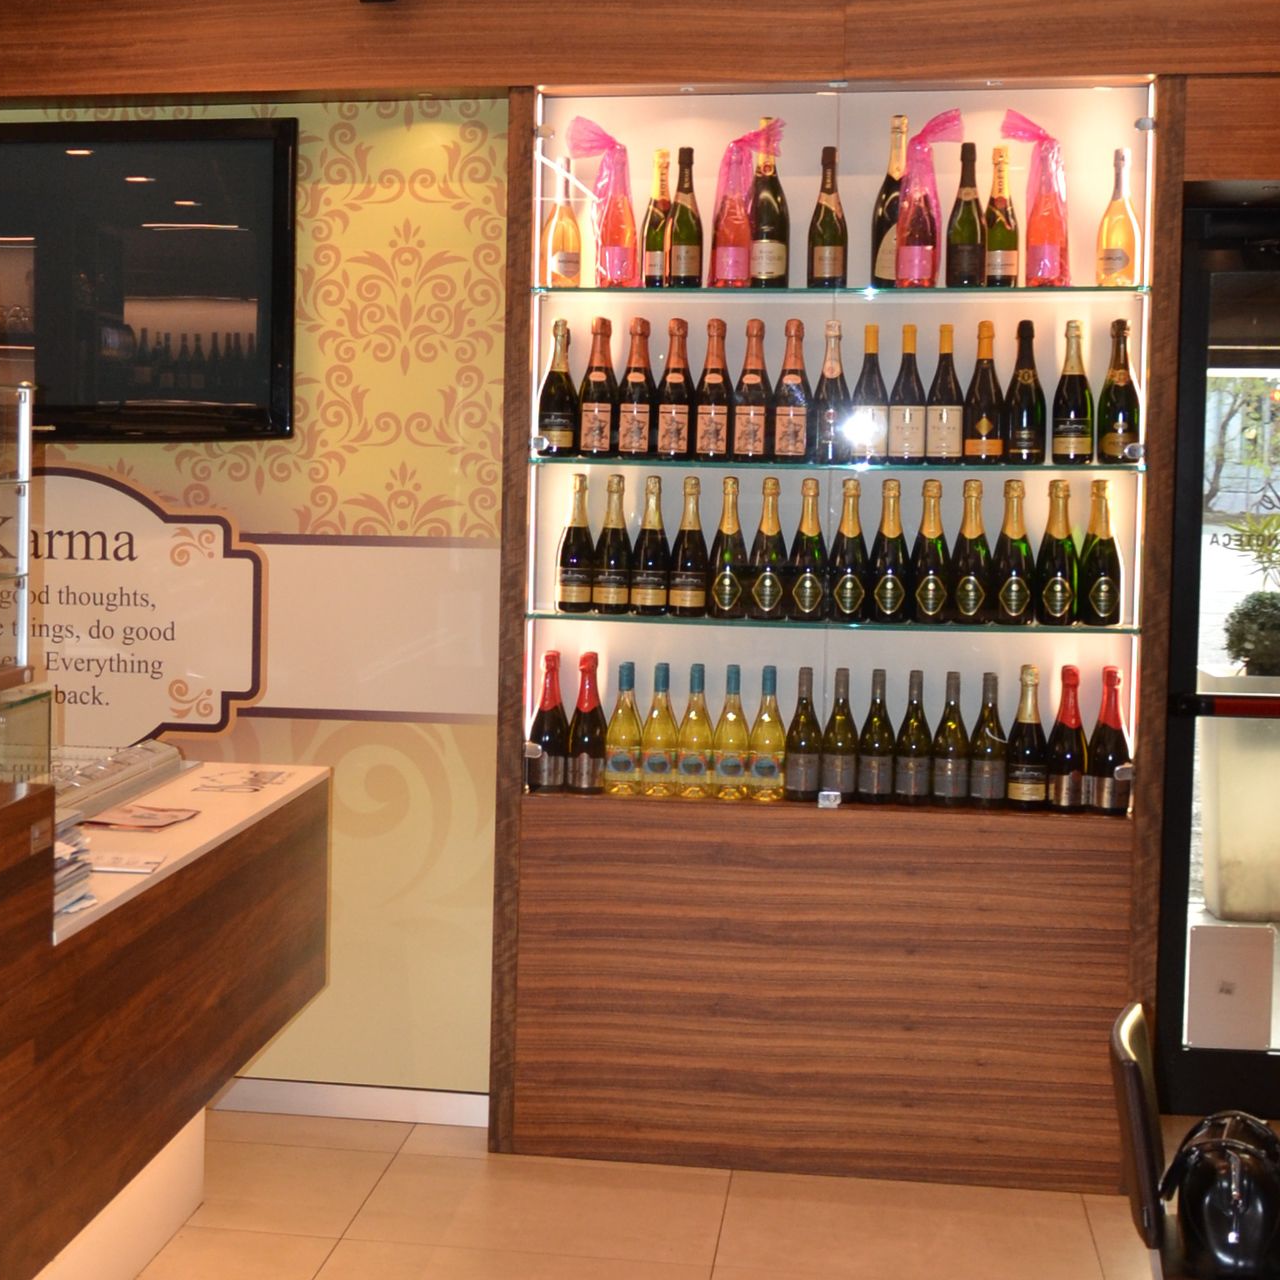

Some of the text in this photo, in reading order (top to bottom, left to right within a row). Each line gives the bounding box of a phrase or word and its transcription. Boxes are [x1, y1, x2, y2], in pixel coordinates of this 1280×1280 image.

[58, 586, 156, 610] thoughts,
[12, 618, 81, 644] tings,
[88, 620, 115, 640] do
[122, 621, 176, 645] good
[45, 651, 164, 679] Everything
[54, 685, 110, 706] back.
